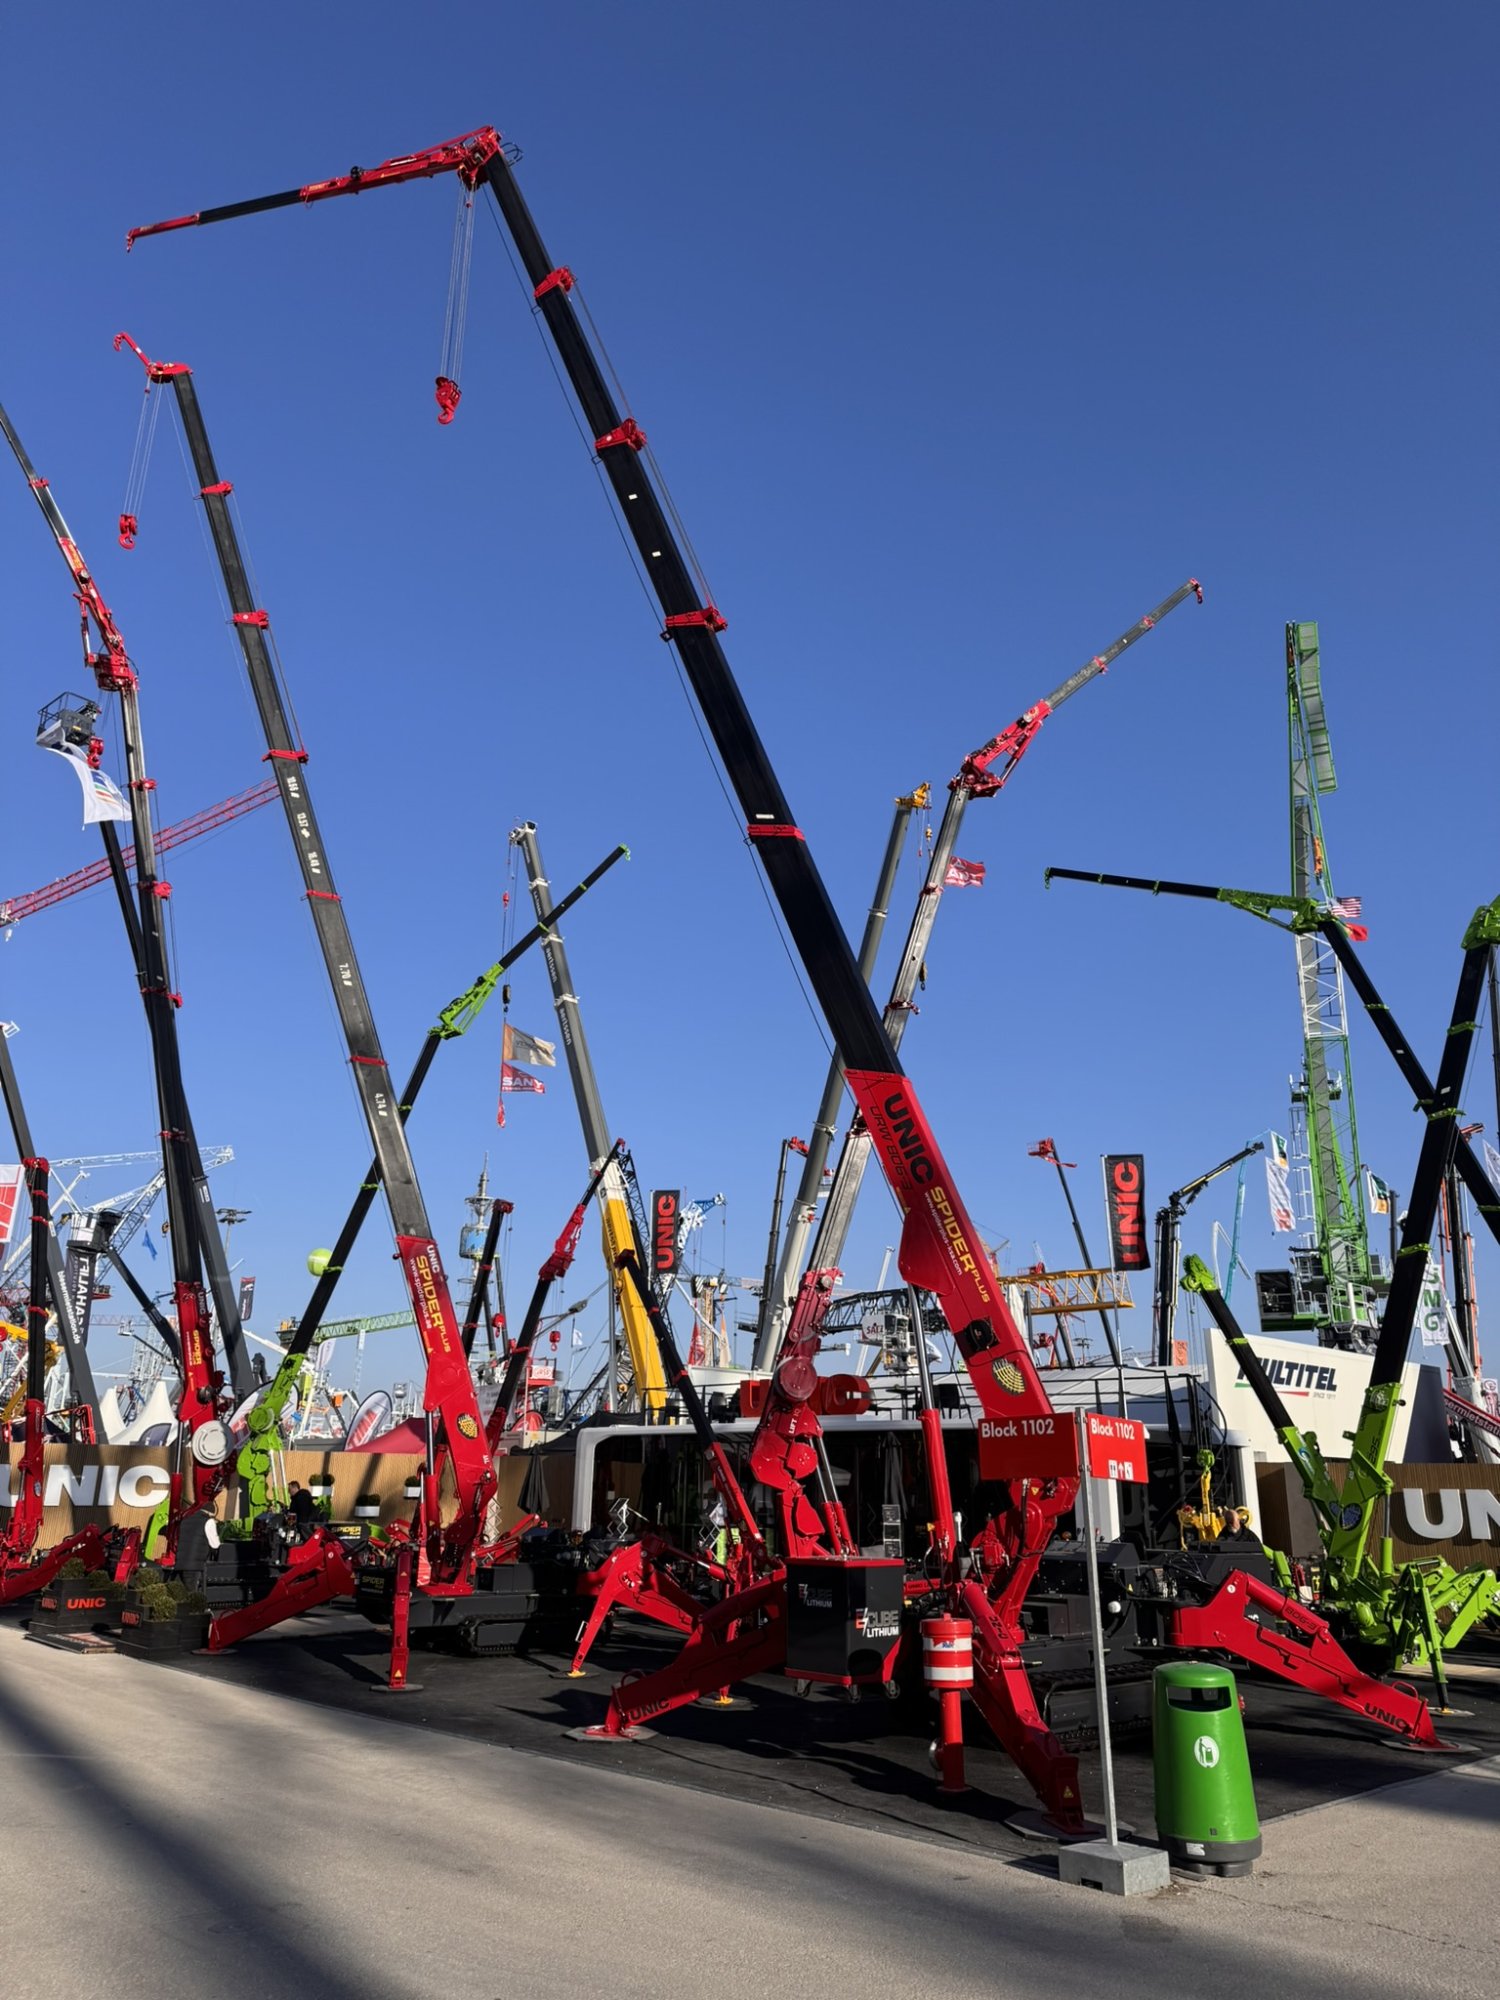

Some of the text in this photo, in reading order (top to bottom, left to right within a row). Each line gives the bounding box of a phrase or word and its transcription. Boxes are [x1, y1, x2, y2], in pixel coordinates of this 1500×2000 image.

[869, 1105, 893, 1143] URW
[884, 1091, 934, 1185] UNIC
[1114, 1161, 1140, 1263] UNIC
[657, 1194, 677, 1269] UNIC
[929, 1186, 991, 1303] SPIDER PLUS
[426, 1244, 440, 1273] UNIC
[416, 1254, 451, 1353] SPIDER PLUS
[1237, 1357, 1337, 1392] ULTITEL
[981, 1419, 1055, 1438] Block 1102
[1091, 1418, 1135, 1440] Block 1102
[66, 1597, 107, 1610] UNIC
[867, 1625, 899, 1638] LITHIUM
[629, 1699, 670, 1721] UNIC
[1364, 1703, 1412, 1732] UNIC
